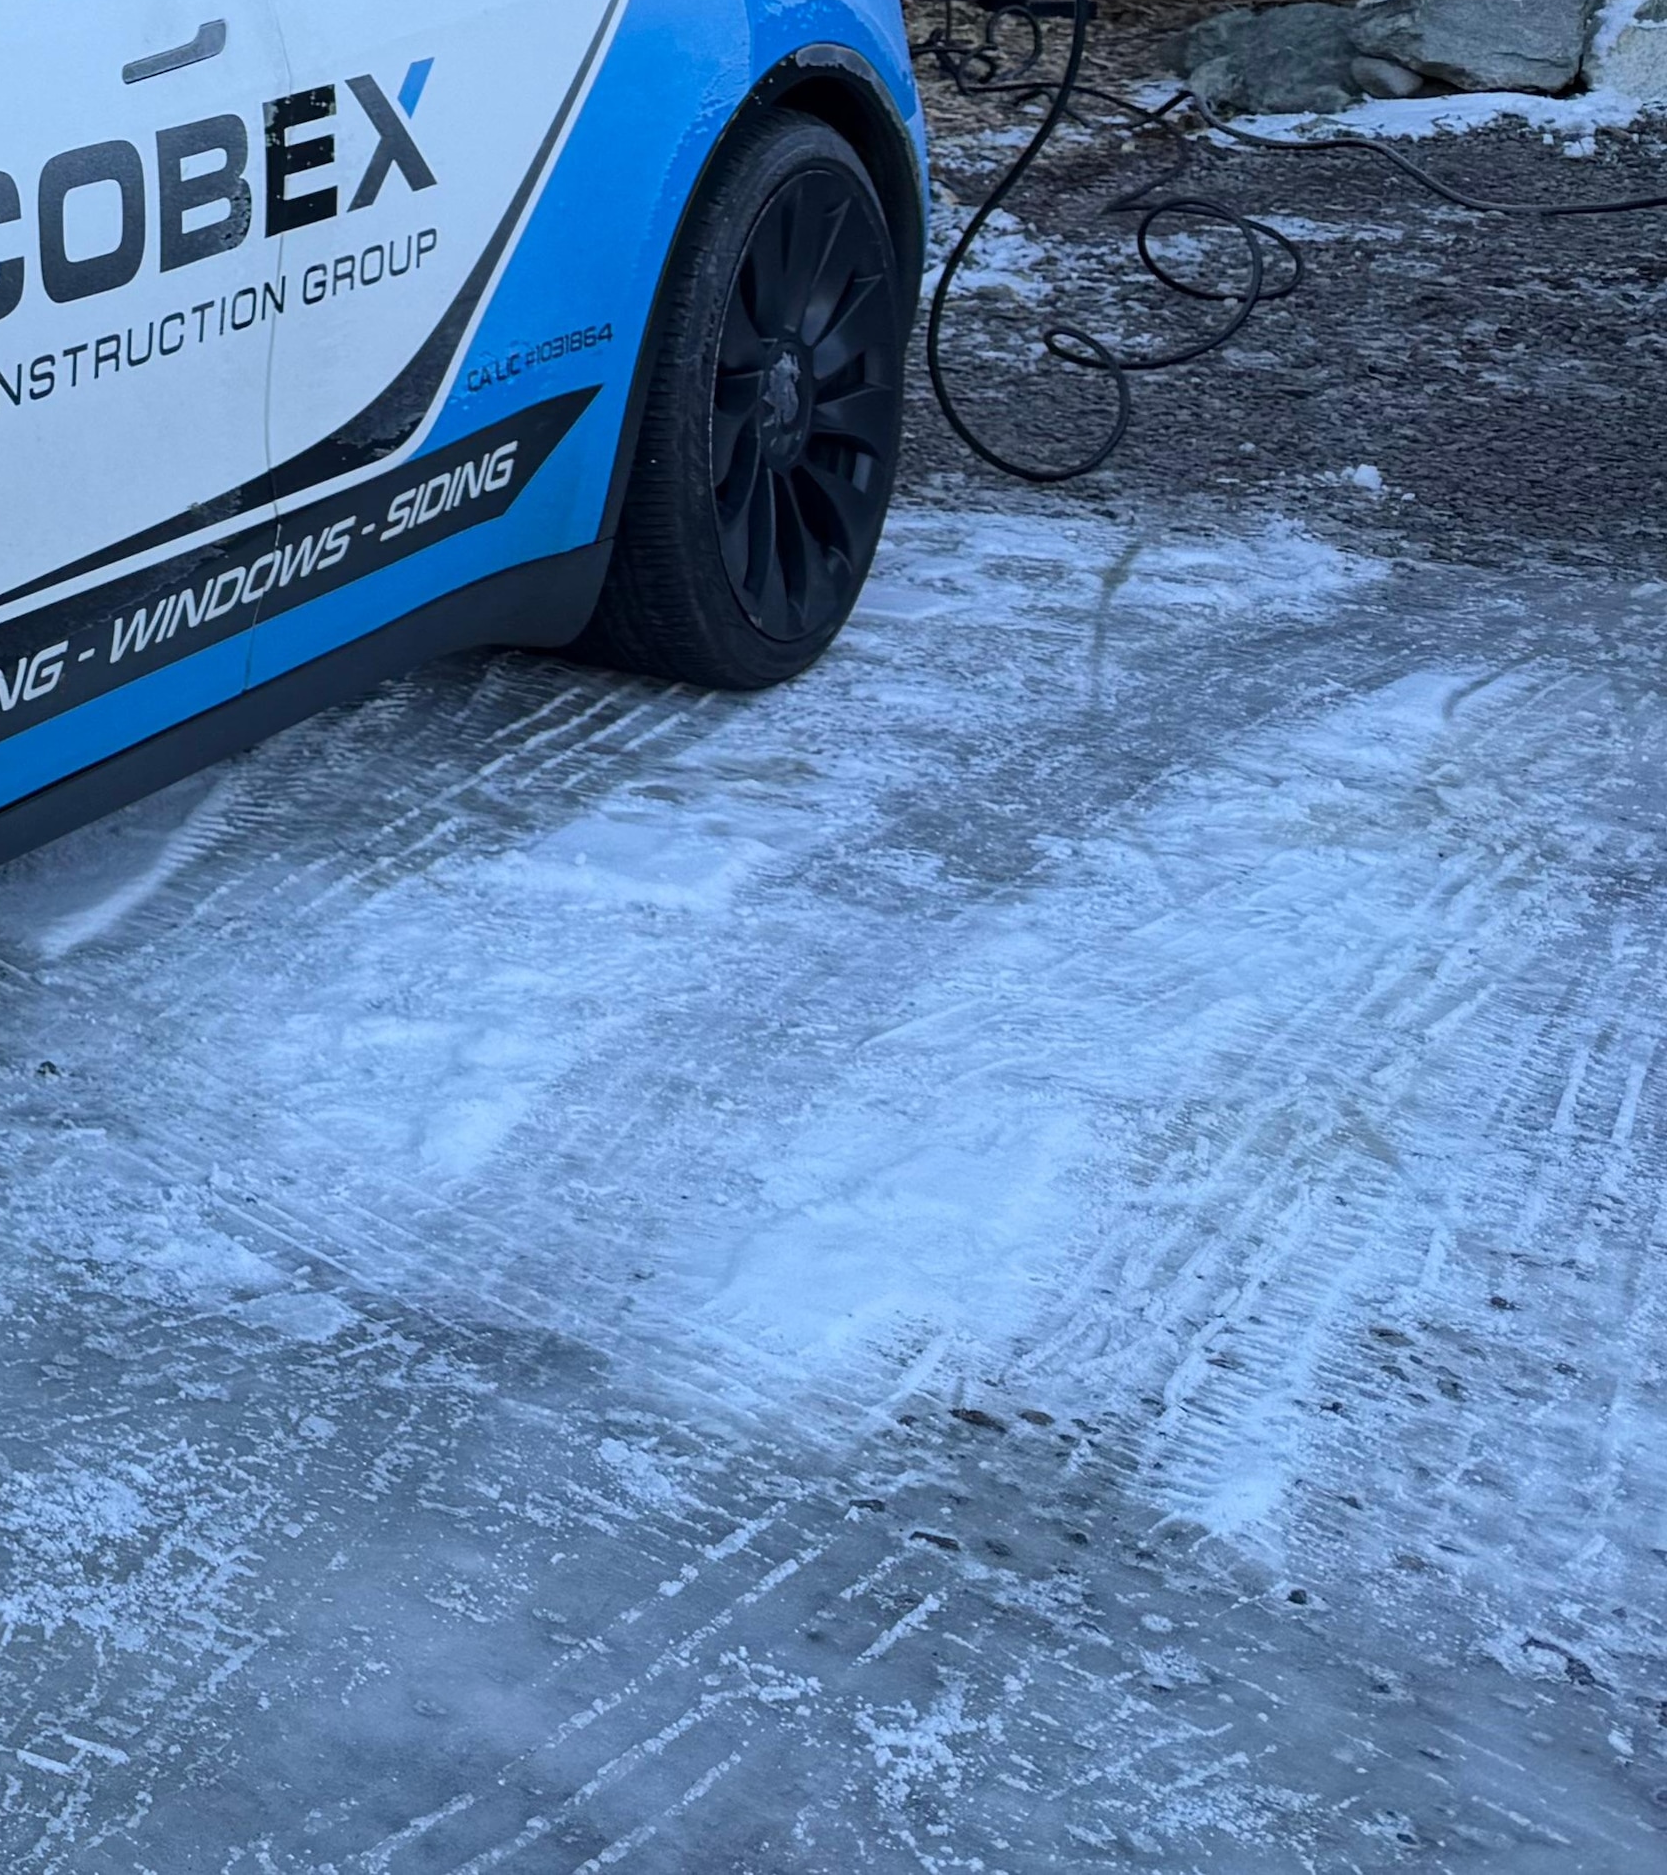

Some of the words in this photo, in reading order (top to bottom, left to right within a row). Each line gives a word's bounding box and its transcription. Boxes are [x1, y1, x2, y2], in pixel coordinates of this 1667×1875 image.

[302, 227, 438, 305] GROUP
[109, 515, 357, 664] WINDOWS
[379, 440, 519, 542] SIDING
